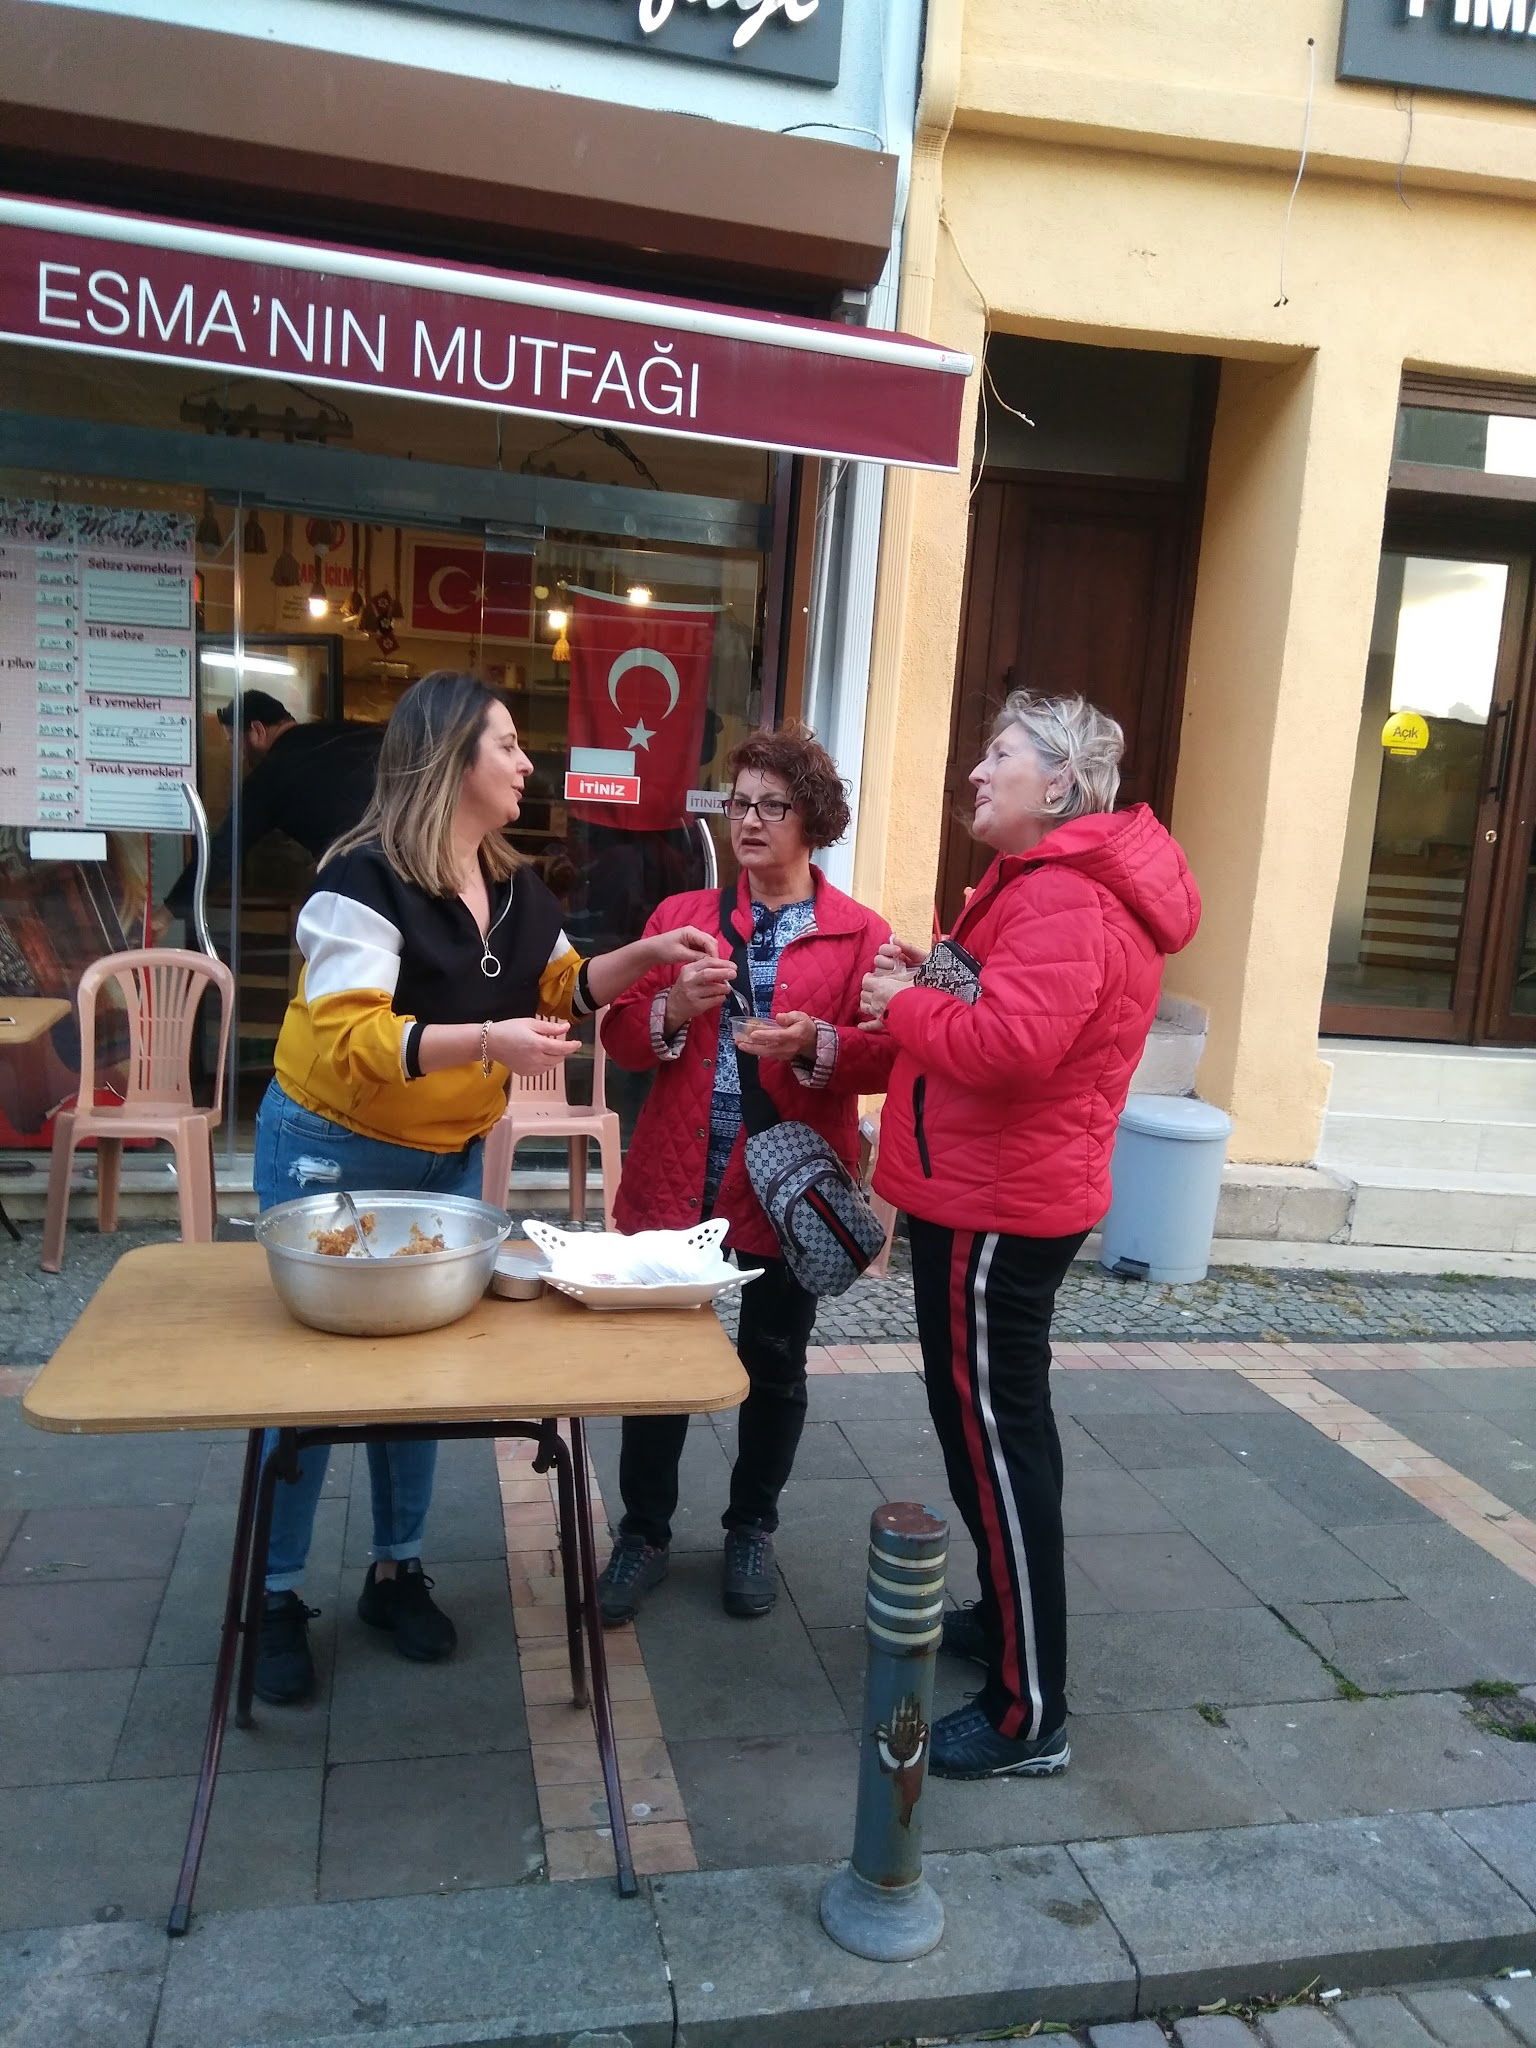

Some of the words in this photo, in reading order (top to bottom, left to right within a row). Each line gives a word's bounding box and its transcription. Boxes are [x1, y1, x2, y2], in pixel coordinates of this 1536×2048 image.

[414, 319, 699, 418] MUTFAĞI
[126, 563, 182, 575] yemekleri
[105, 698, 161, 711] yemekleri
[1393, 727, 1418, 740] Açık
[89, 762, 124, 774] Tavuk
[127, 766, 183, 777] yemekleri
[580, 780, 625, 796] İTİNİZ
